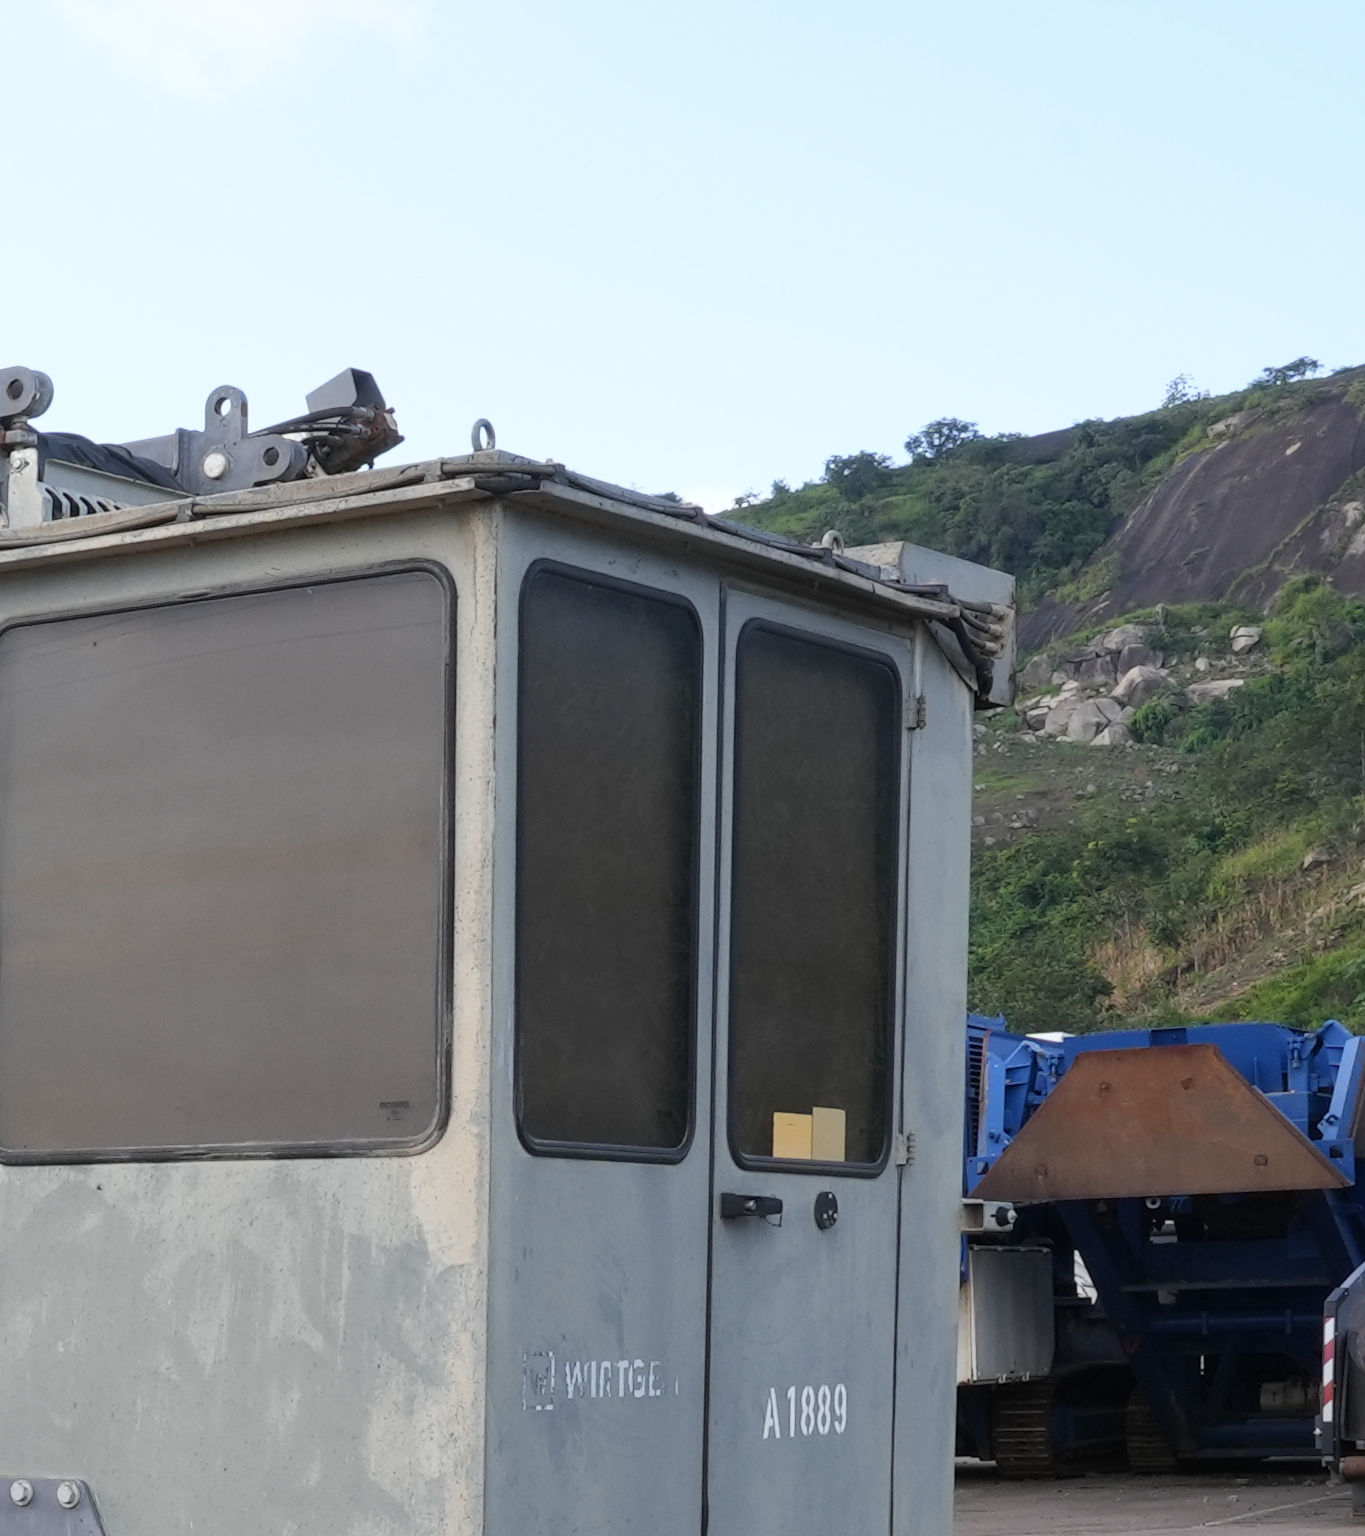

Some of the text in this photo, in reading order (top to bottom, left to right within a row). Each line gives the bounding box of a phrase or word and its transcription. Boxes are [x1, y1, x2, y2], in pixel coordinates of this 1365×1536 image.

[564, 1358, 679, 1399] WIRTGE
[762, 1383, 848, 1440] A 1889
